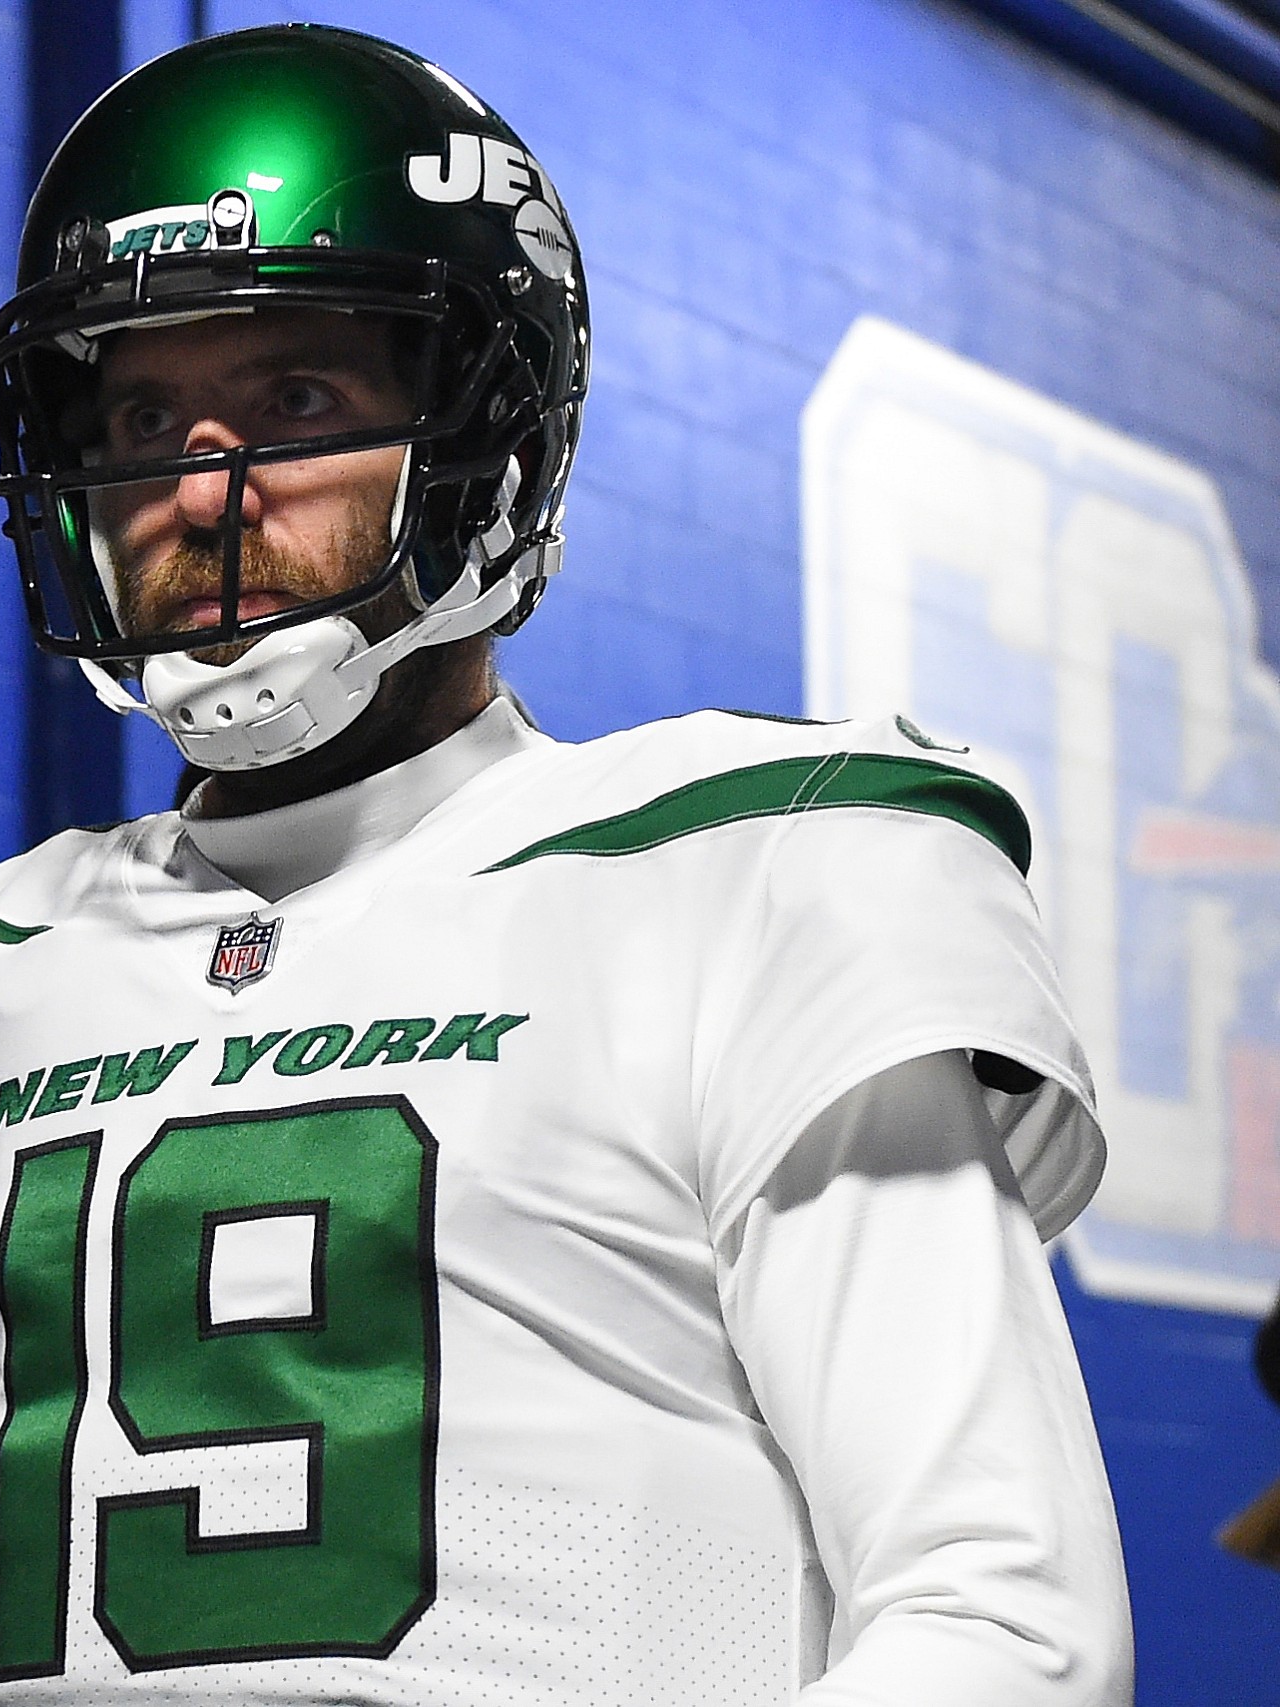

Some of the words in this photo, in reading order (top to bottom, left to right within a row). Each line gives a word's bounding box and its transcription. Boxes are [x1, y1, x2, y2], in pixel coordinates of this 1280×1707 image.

[409, 132, 563, 224] JET
[111, 220, 210, 258] JETS
[215, 946, 261, 976] NFL
[211, 1012, 530, 1086] YORK
